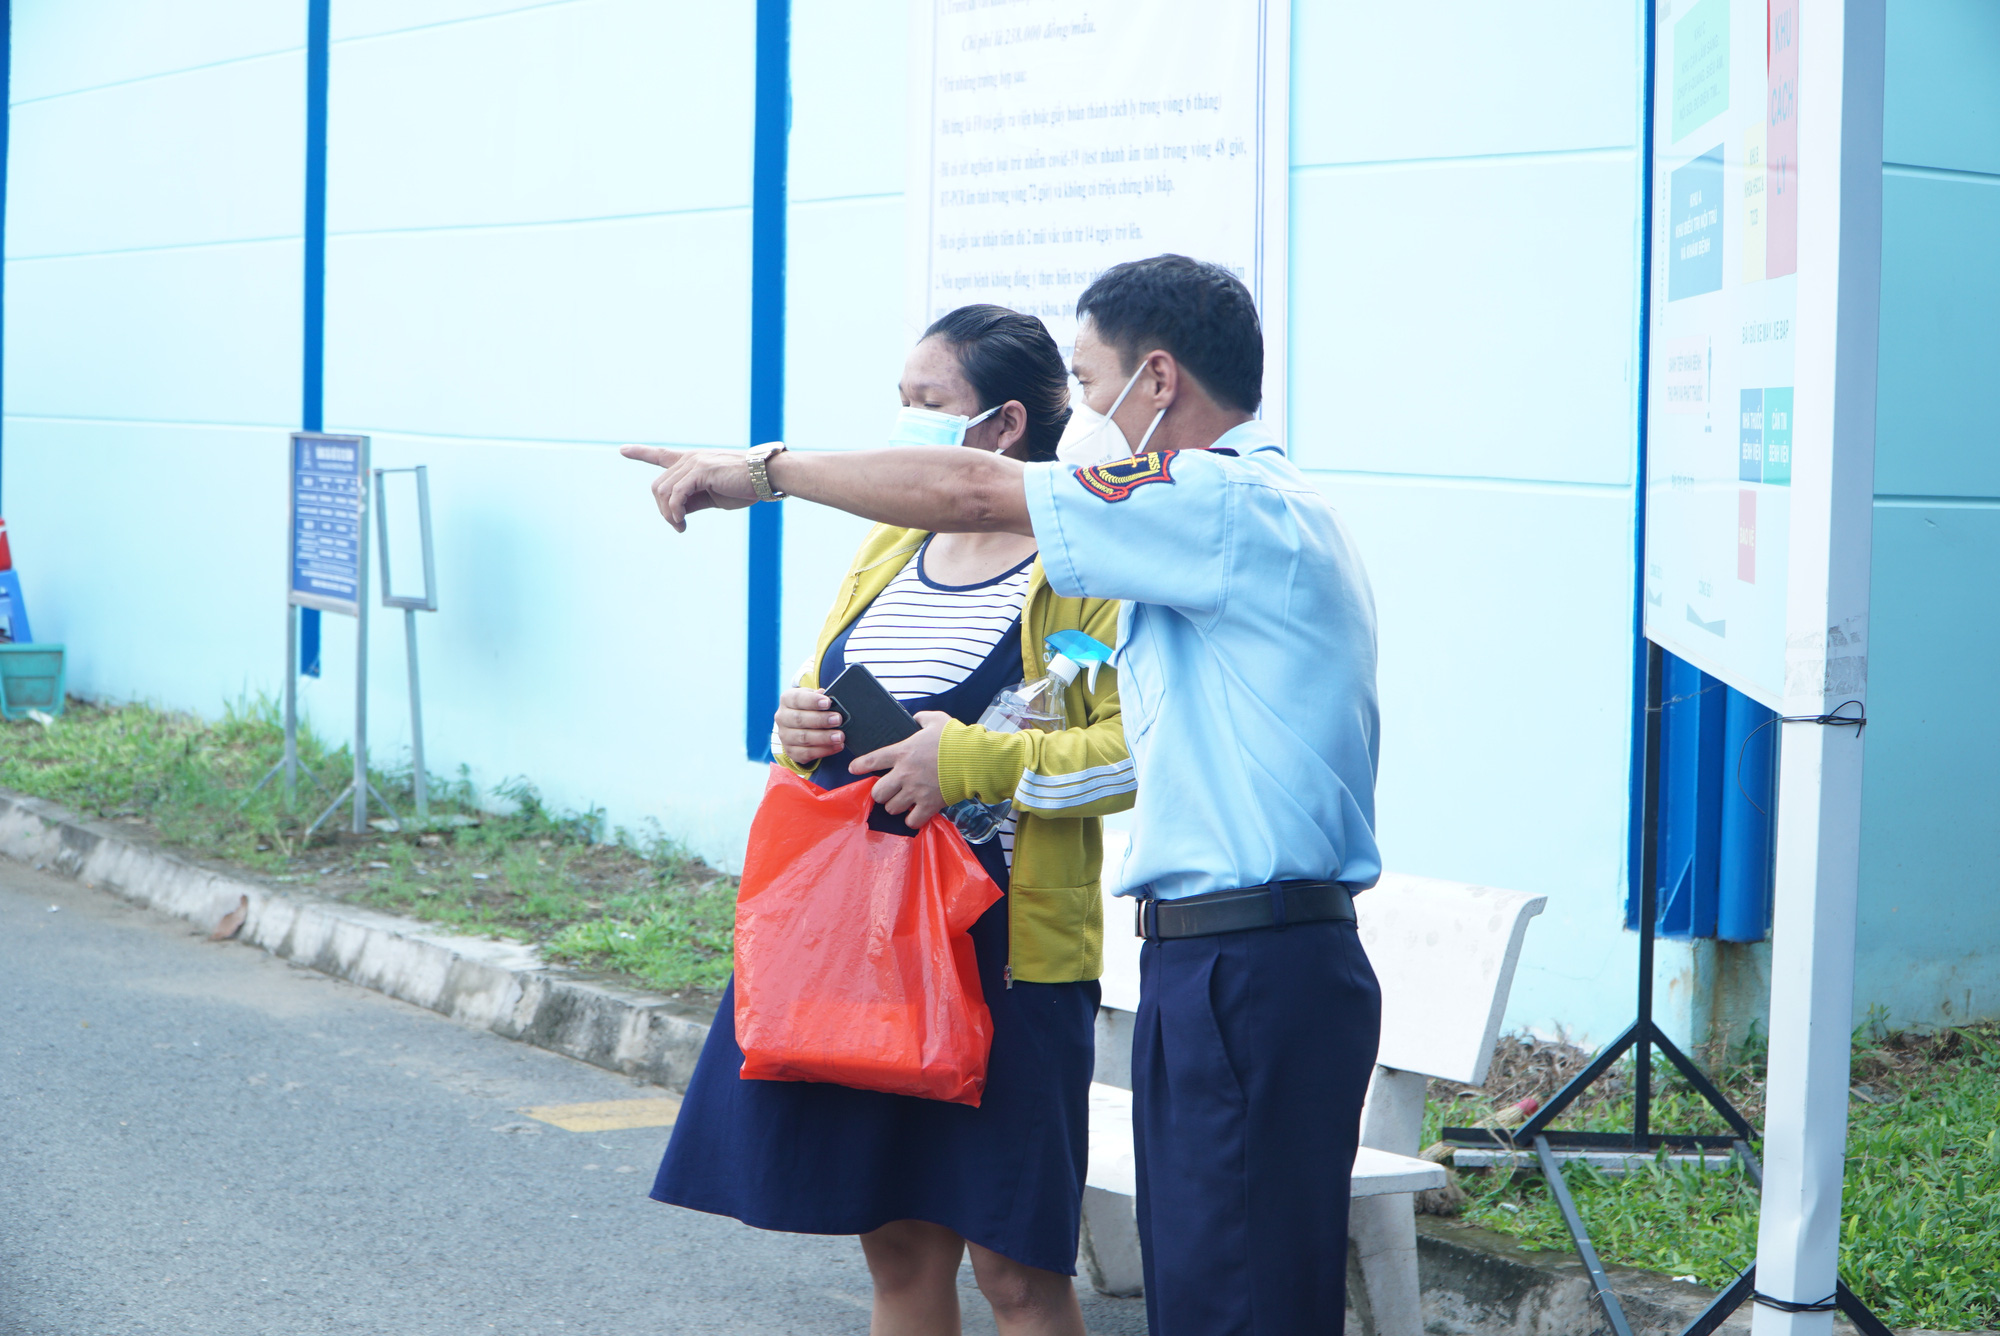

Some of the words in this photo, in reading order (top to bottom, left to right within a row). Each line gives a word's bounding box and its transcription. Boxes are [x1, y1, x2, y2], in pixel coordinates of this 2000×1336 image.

[1775, 8, 1791, 55] KHU
[1087, 101, 1108, 120] thành
[1110, 98, 1127, 118] cách
[1139, 99, 1161, 118] trong
[1163, 95, 1184, 117] vòng
[1186, 92, 1192, 111] 6
[1194, 91, 1222, 113] tháng)
[1771, 74, 1794, 127] CÁCH
[1100, 147, 1125, 164] nhanh
[1128, 144, 1141, 162] âm
[1144, 143, 1159, 161] tính
[1163, 146, 1187, 163] trong
[1191, 139, 1212, 159] vòng
[1215, 137, 1225, 156] 48
[1776, 154, 1787, 196] LY
[1064, 179, 1086, 201] không
[1118, 178, 1142, 197] chứng
[1689, 191, 1698, 209] KHU
[1698, 189, 1703, 205] A
[1675, 223, 1684, 240] KHU
[1698, 236, 1711, 258] BỆNH
[1742, 407, 1750, 430] NHÀ
[1750, 405, 1762, 430] THUỐC
[1780, 412, 1788, 431] TIN
[1742, 438, 1752, 464] BỆNH
[1752, 439, 1761, 465] VIỆN
[1768, 440, 1780, 466] BỆNH
[1780, 440, 1790, 467] VIỆN
[1739, 520, 1748, 546] BẢO
